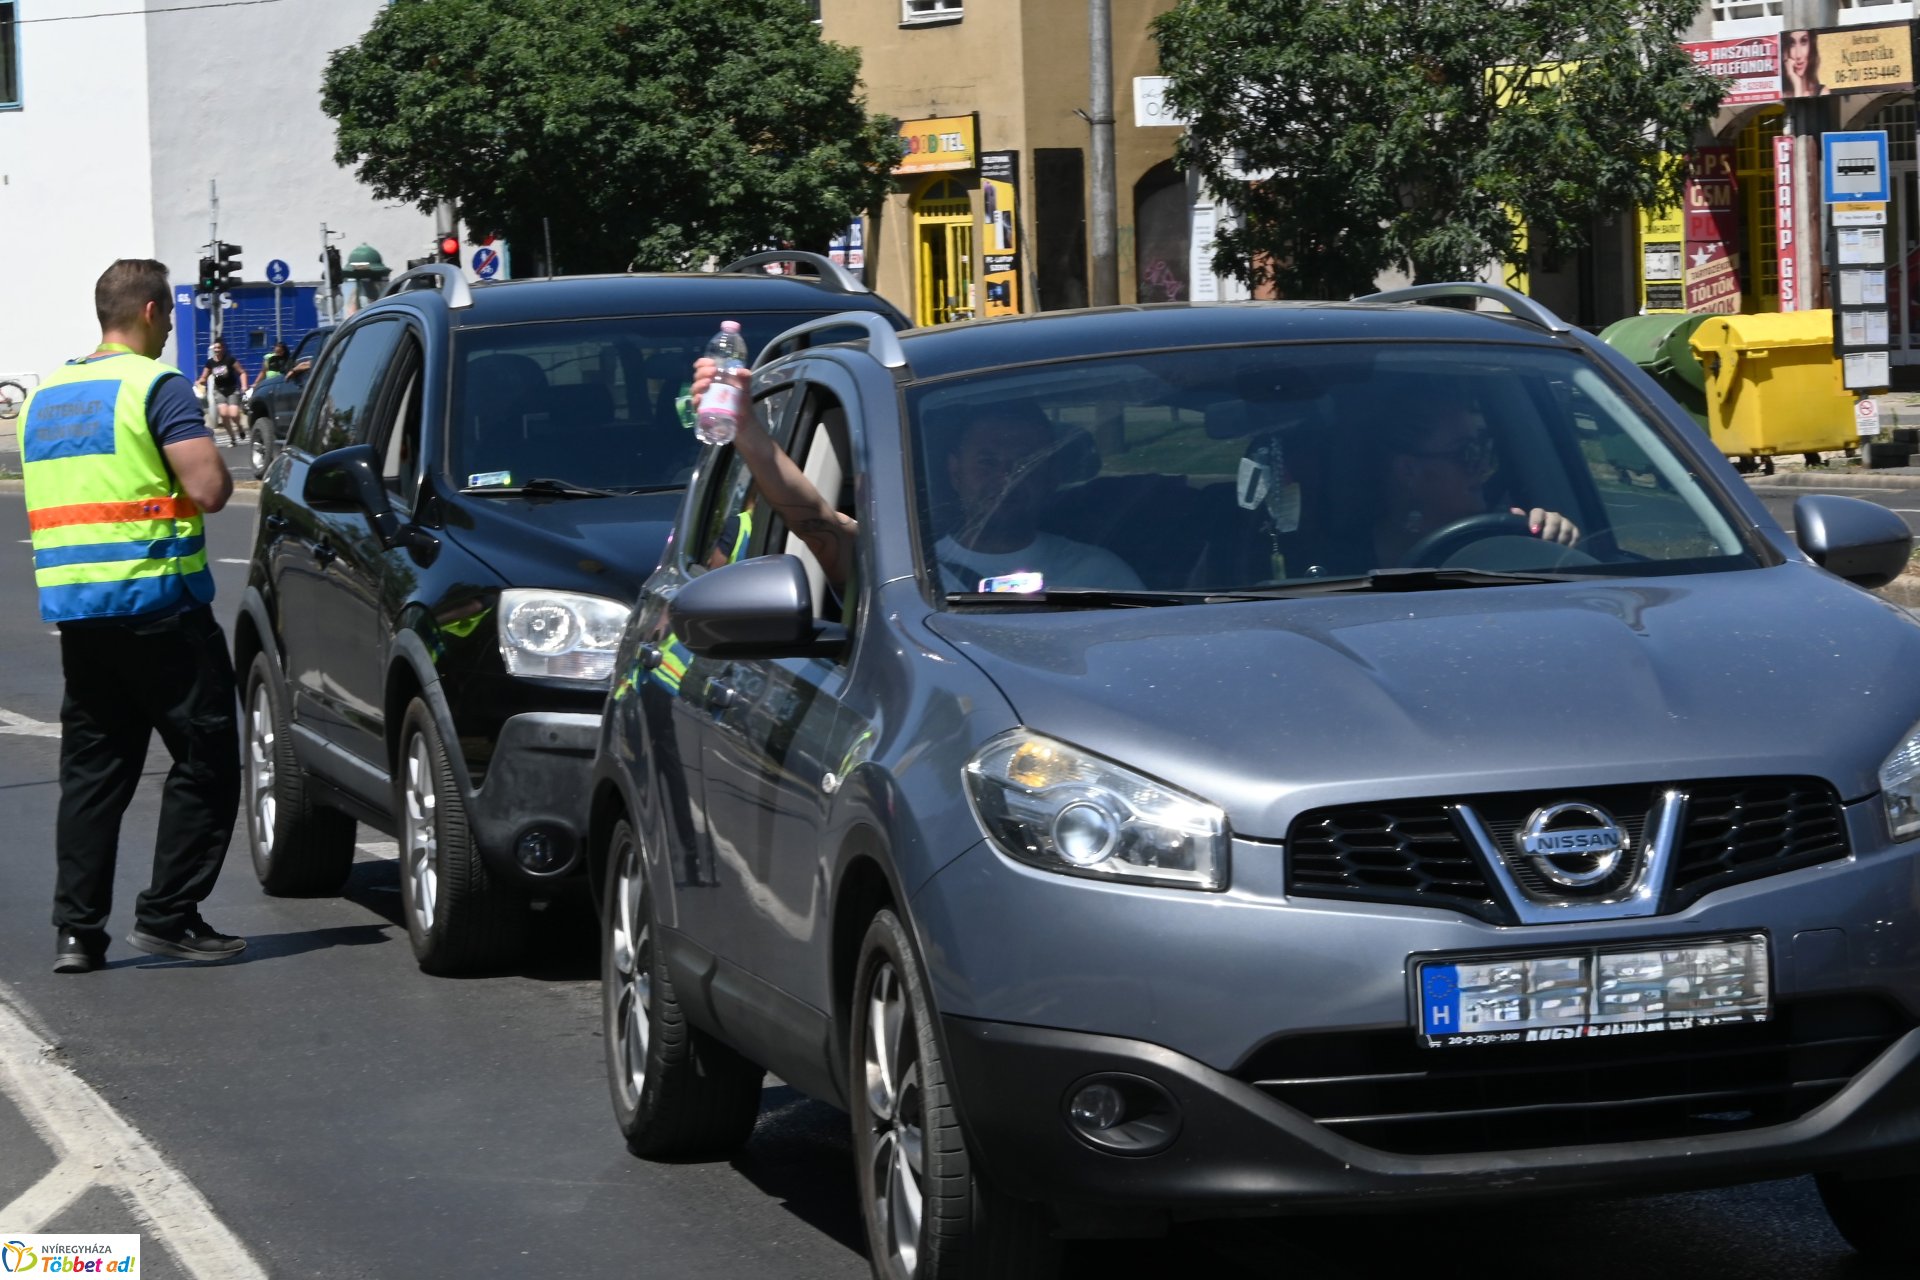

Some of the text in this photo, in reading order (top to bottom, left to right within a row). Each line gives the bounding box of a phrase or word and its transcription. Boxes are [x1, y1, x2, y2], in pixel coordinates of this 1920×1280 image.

[1693, 41, 1773, 62] és HASZNÁLT
[1690, 184, 1731, 207] GSM
[1778, 141, 1793, 250] CHAMP
[1538, 832, 1618, 850] NISSAN
[1432, 1005, 1451, 1026] H
